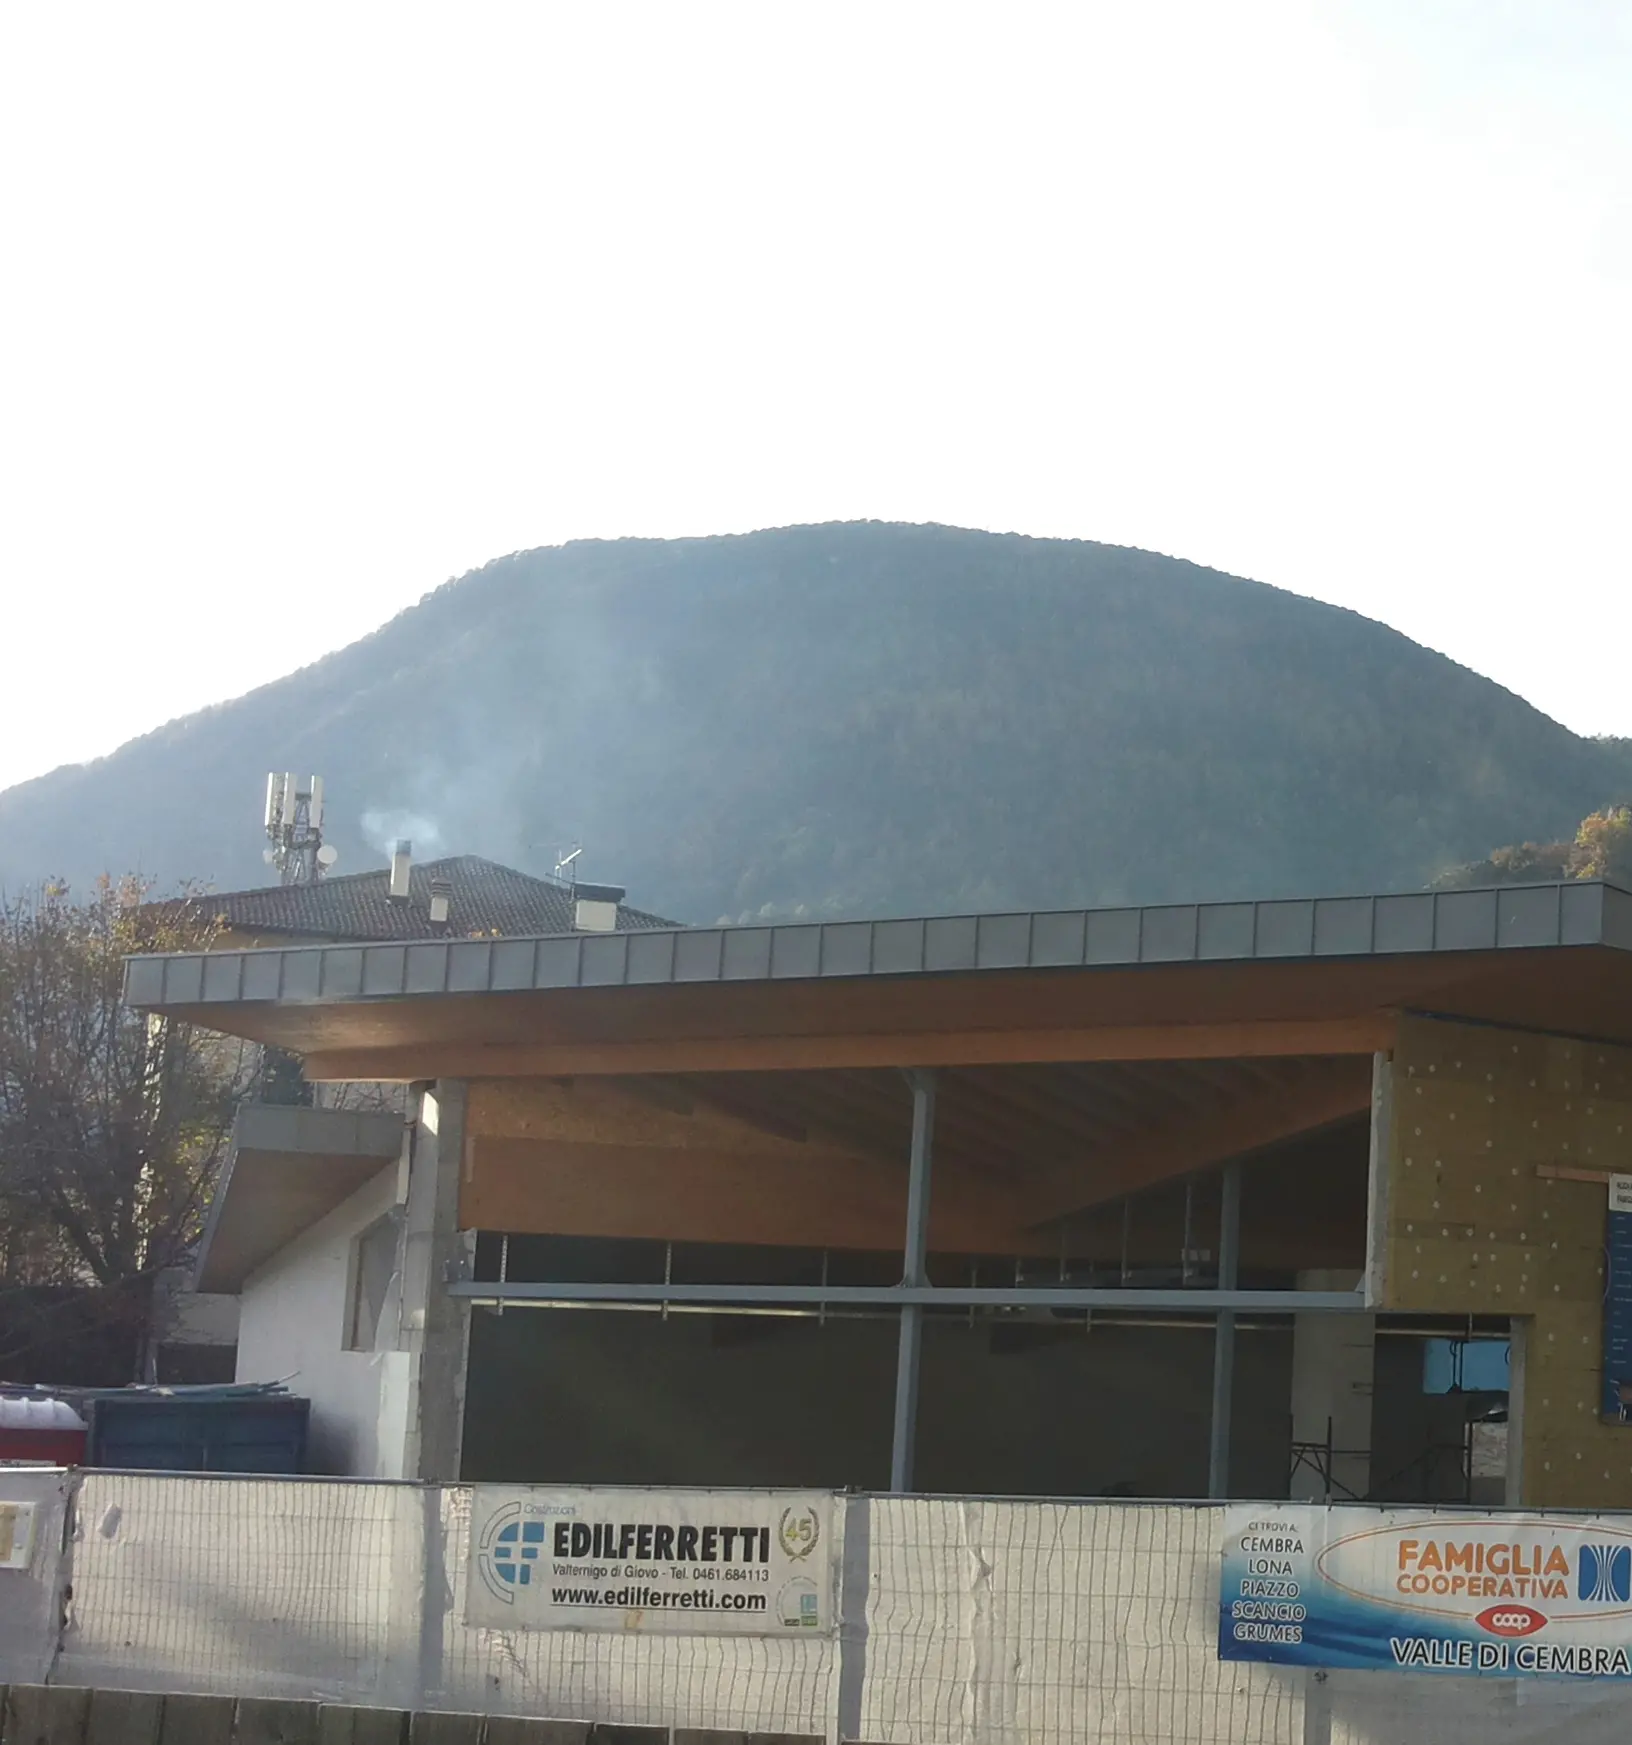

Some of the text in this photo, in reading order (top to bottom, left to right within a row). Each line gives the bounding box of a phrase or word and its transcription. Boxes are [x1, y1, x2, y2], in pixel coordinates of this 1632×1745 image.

[785, 1517, 812, 1541] 45
[1248, 1521, 1259, 1532] CI
[1261, 1522, 1287, 1532] TROVI
[553, 1522, 770, 1563] EDILFERRETTI
[1240, 1536, 1304, 1554] CEMBRA
[1248, 1558, 1293, 1575] LONA
[1398, 1540, 1570, 1576] FAMIGLIA
[552, 1564, 608, 1580] Valternigo
[610, 1565, 621, 1578] di
[624, 1565, 659, 1579] Giovo
[670, 1566, 689, 1580] Tel.
[693, 1567, 769, 1582] 0461.684113
[1241, 1580, 1299, 1598] PIAZZO
[1396, 1573, 1569, 1599] COOPERATIVA
[552, 1587, 767, 1610] www.edilferretti.com
[1232, 1601, 1306, 1620] SCANCIO
[1234, 1623, 1302, 1642] GRUMES
[1391, 1637, 1632, 1674] VALLE DI CEMBRA
